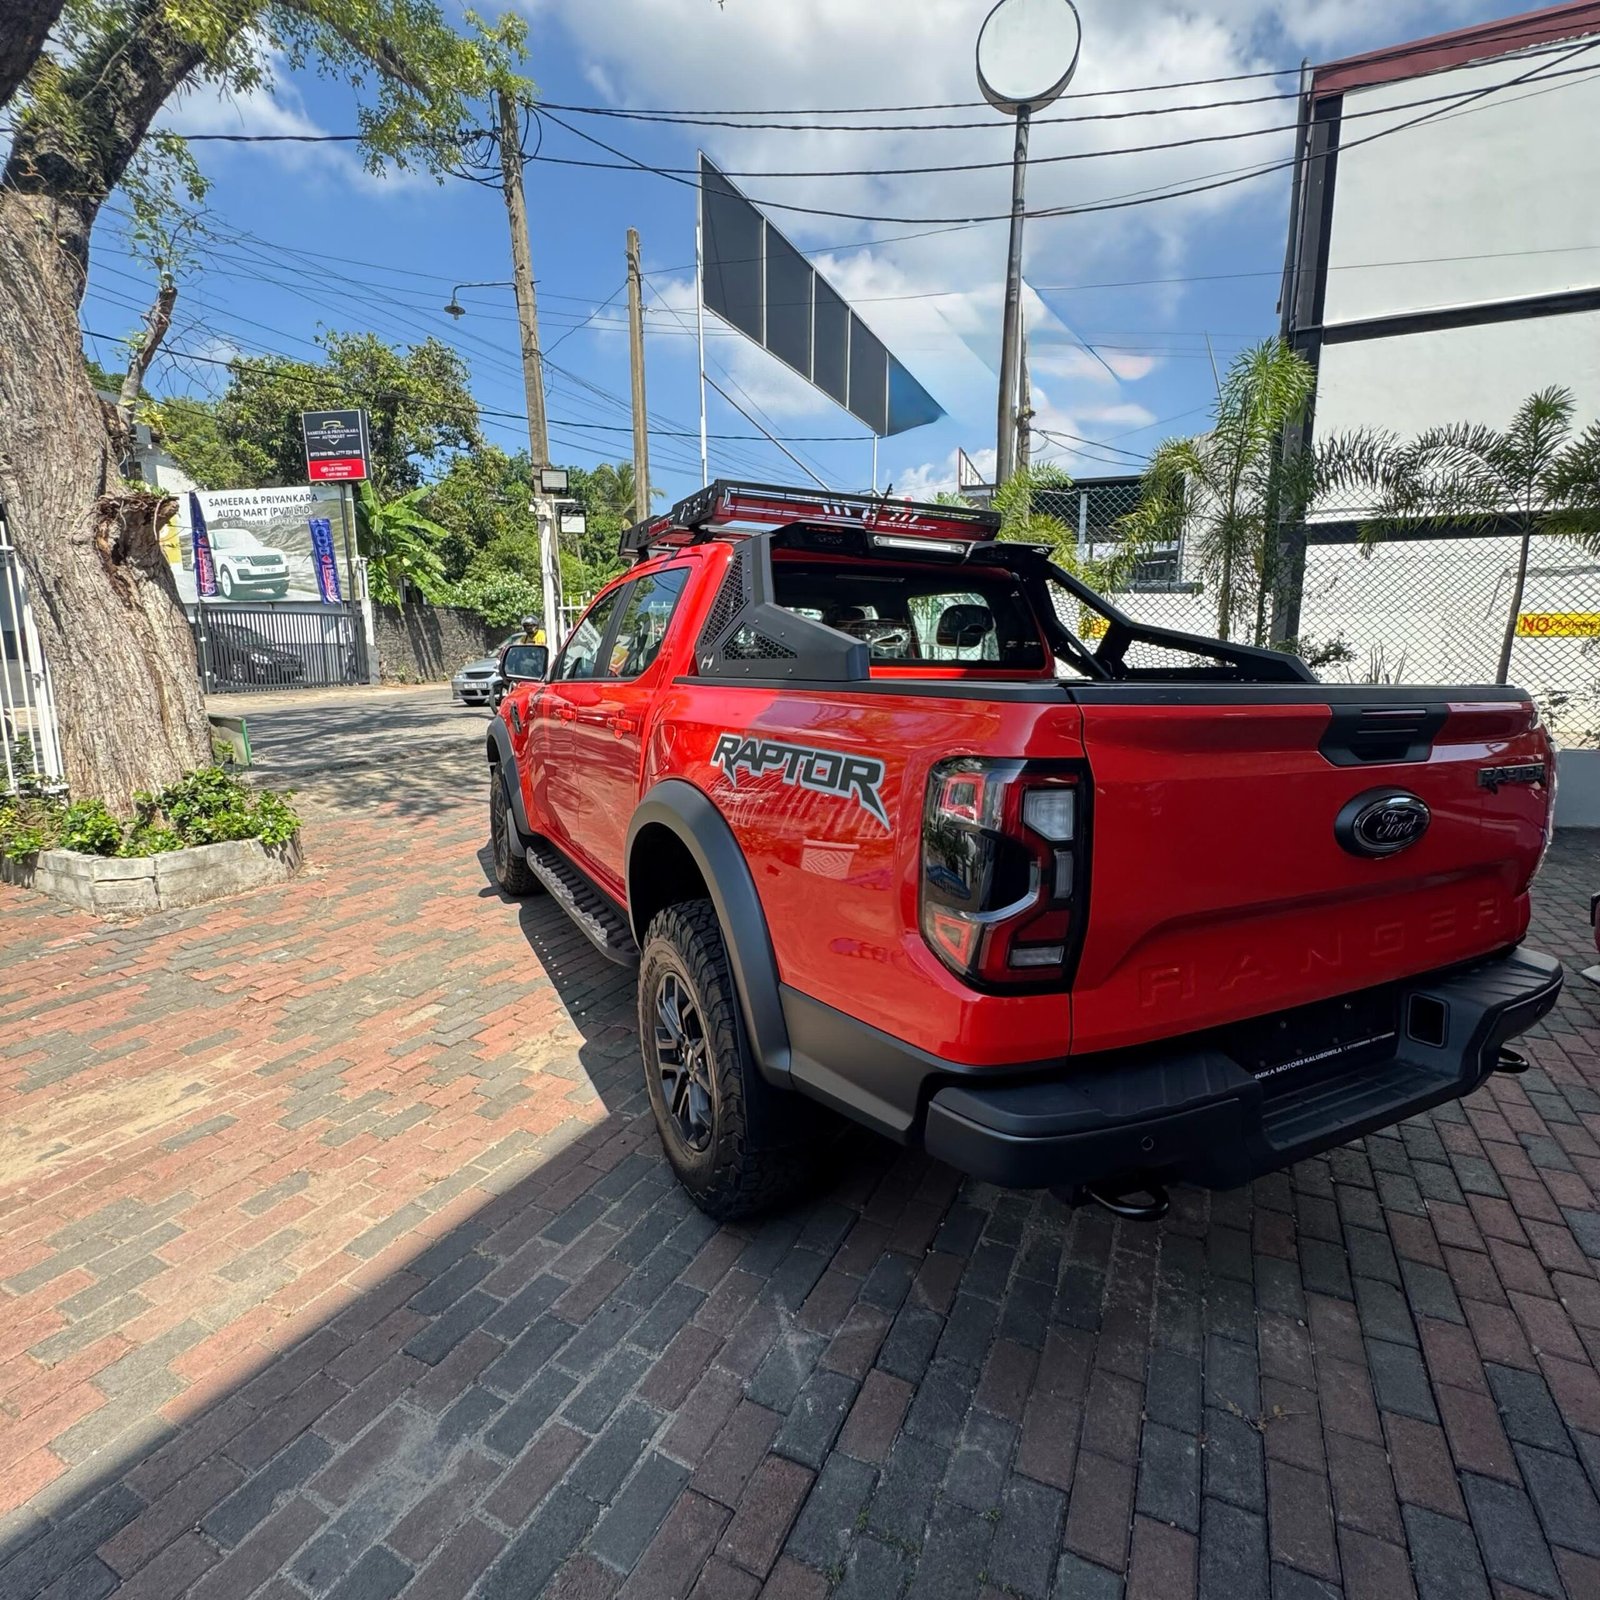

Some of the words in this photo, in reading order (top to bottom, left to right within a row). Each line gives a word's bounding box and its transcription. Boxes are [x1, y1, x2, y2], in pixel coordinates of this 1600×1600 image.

[208, 497, 251, 507] SAMEERA
[252, 496, 259, 505] &
[260, 493, 318, 504] PRIYANKARA
[217, 509, 241, 518] AUTO
[243, 507, 268, 517] MART
[1521, 616, 1549, 632] NO
[710, 733, 891, 832] RAPTOR
[1478, 763, 1546, 795] RAPTOR
[1375, 809, 1418, 839] Ford
[1138, 898, 1502, 1008] RANGER
[1276, 1058, 1304, 1074] MOTORS
